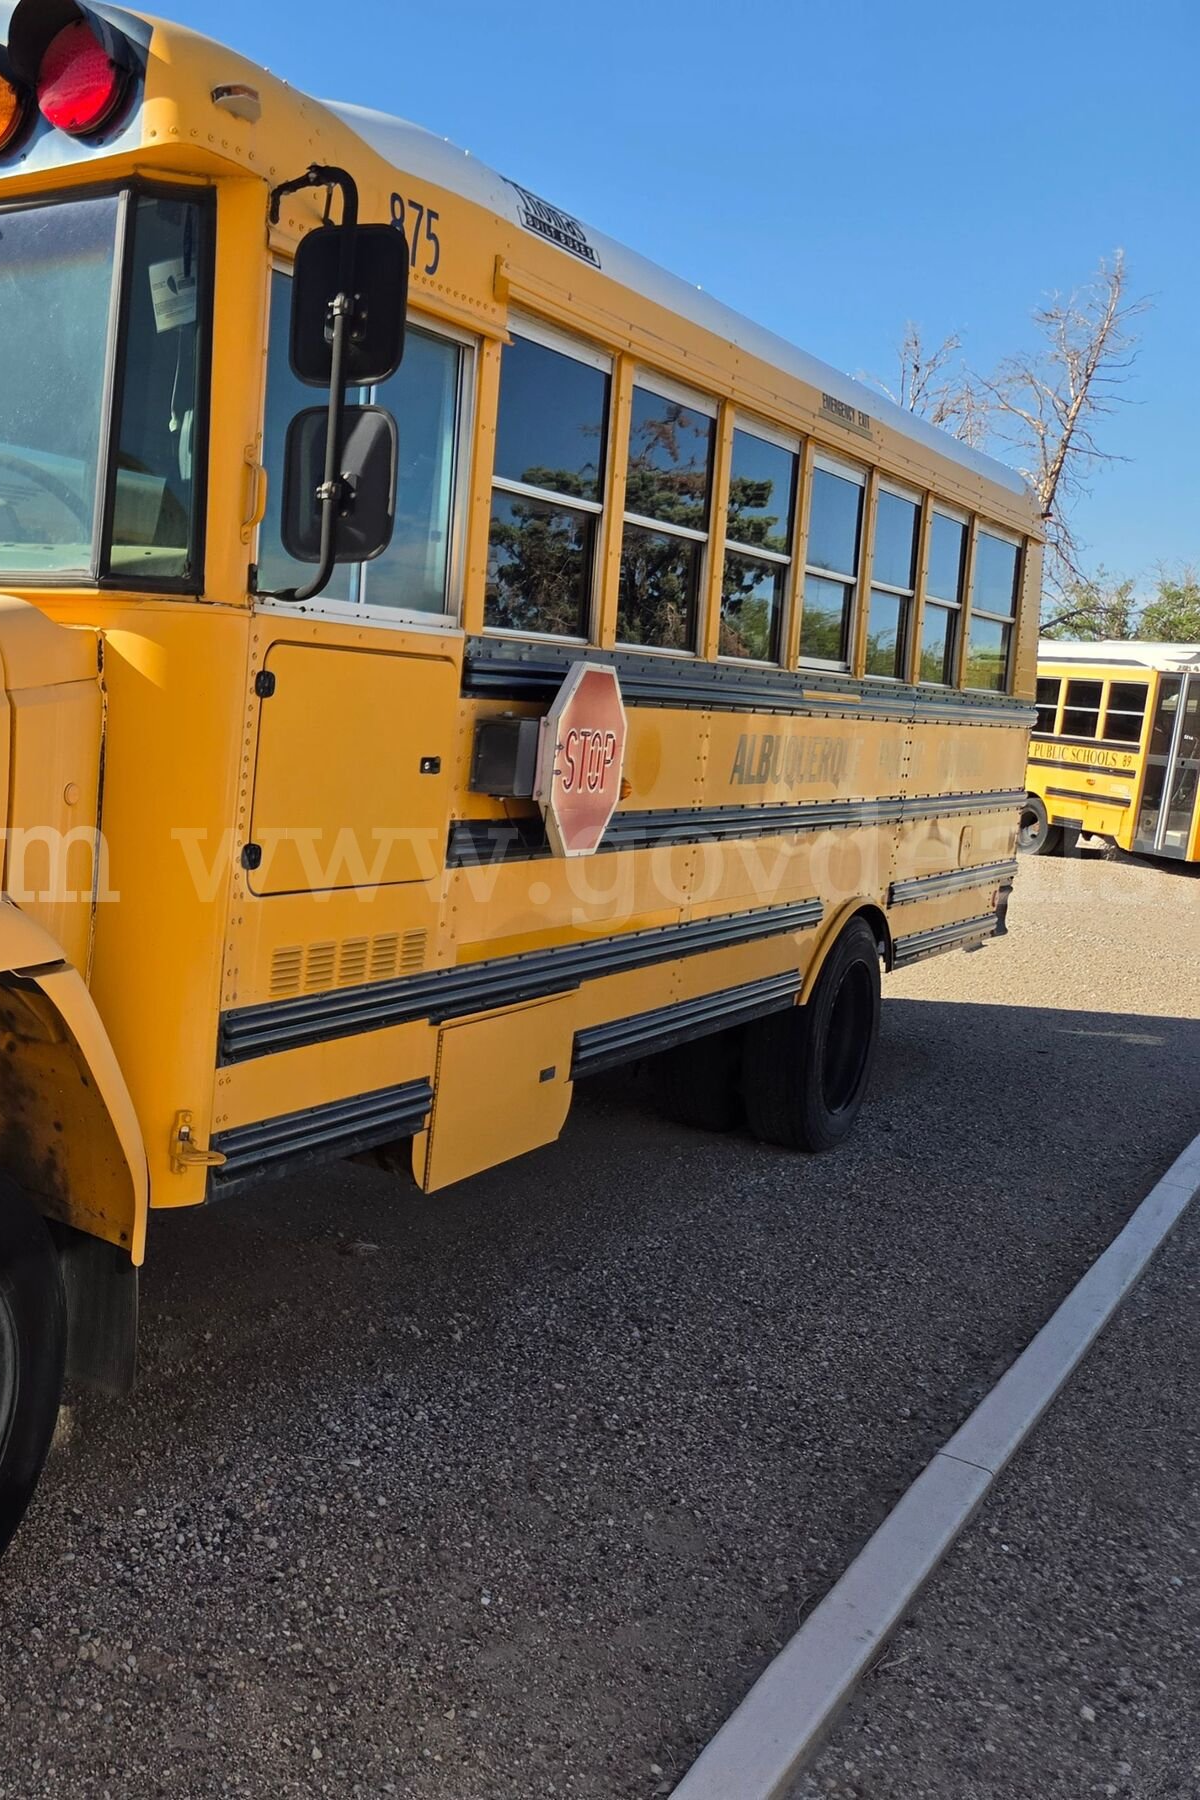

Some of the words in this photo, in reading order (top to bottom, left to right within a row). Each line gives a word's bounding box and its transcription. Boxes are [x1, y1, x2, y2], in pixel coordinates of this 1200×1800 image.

[390, 192, 440, 276] 875
[525, 212, 557, 240] BUILT
[822, 392, 856, 424] EMERGENCY
[857, 410, 871, 430] EXIT
[562, 728, 617, 794] STOP
[1033, 743, 1069, 761] PUBLIC
[1071, 747, 1118, 767] SCHOOLS
